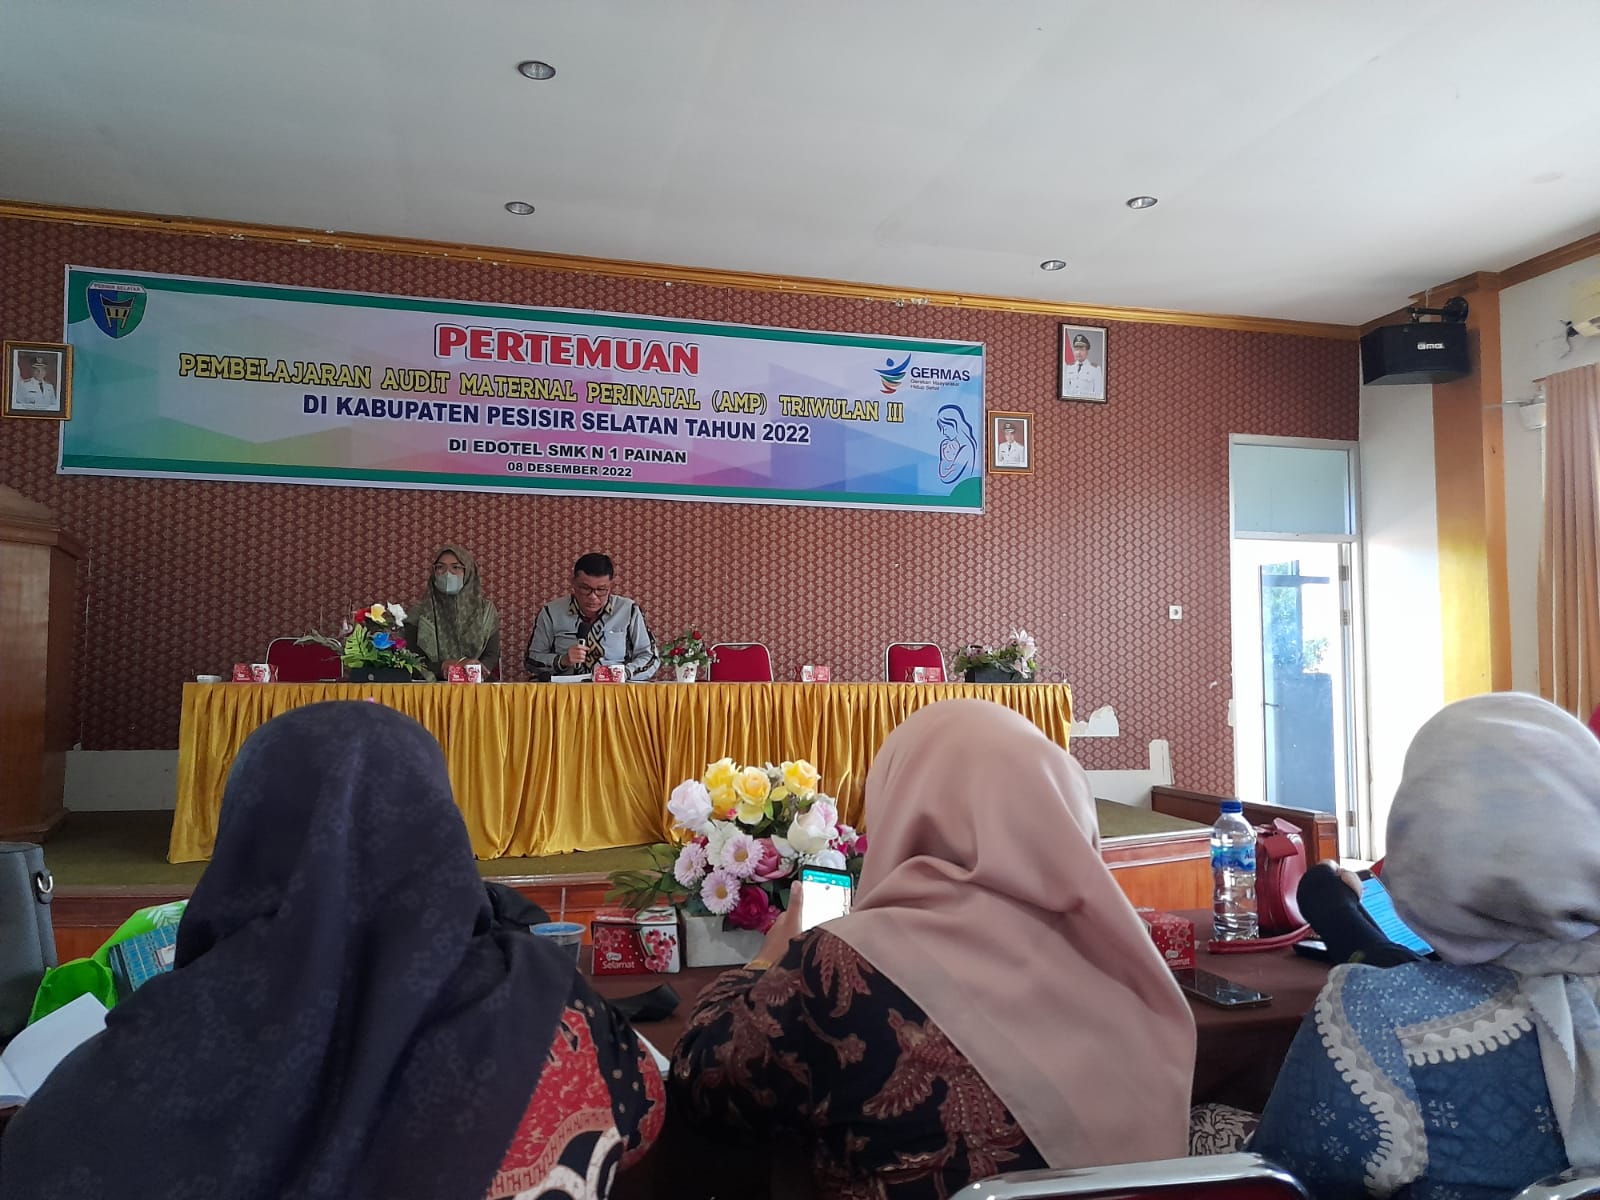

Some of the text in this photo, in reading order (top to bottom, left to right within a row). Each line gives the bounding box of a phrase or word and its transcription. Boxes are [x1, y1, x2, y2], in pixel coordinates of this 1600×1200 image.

[436, 324, 700, 375] PERTEMUAN
[910, 366, 970, 382] GERMAS
[179, 353, 904, 423] PEMBELAJARAN AUDIT MATERNAL PERINATAL (AMP) TRIWULAN III
[303, 394, 809, 443] DI KABUPATEN PESISIR SELATAN TAHUN 2022
[449, 438, 687, 463] DI EDOTEL SMK N 1 PAINAN
[507, 462, 632, 477] 08 DESEMBER 2022
[602, 960, 635, 969] Selamat
